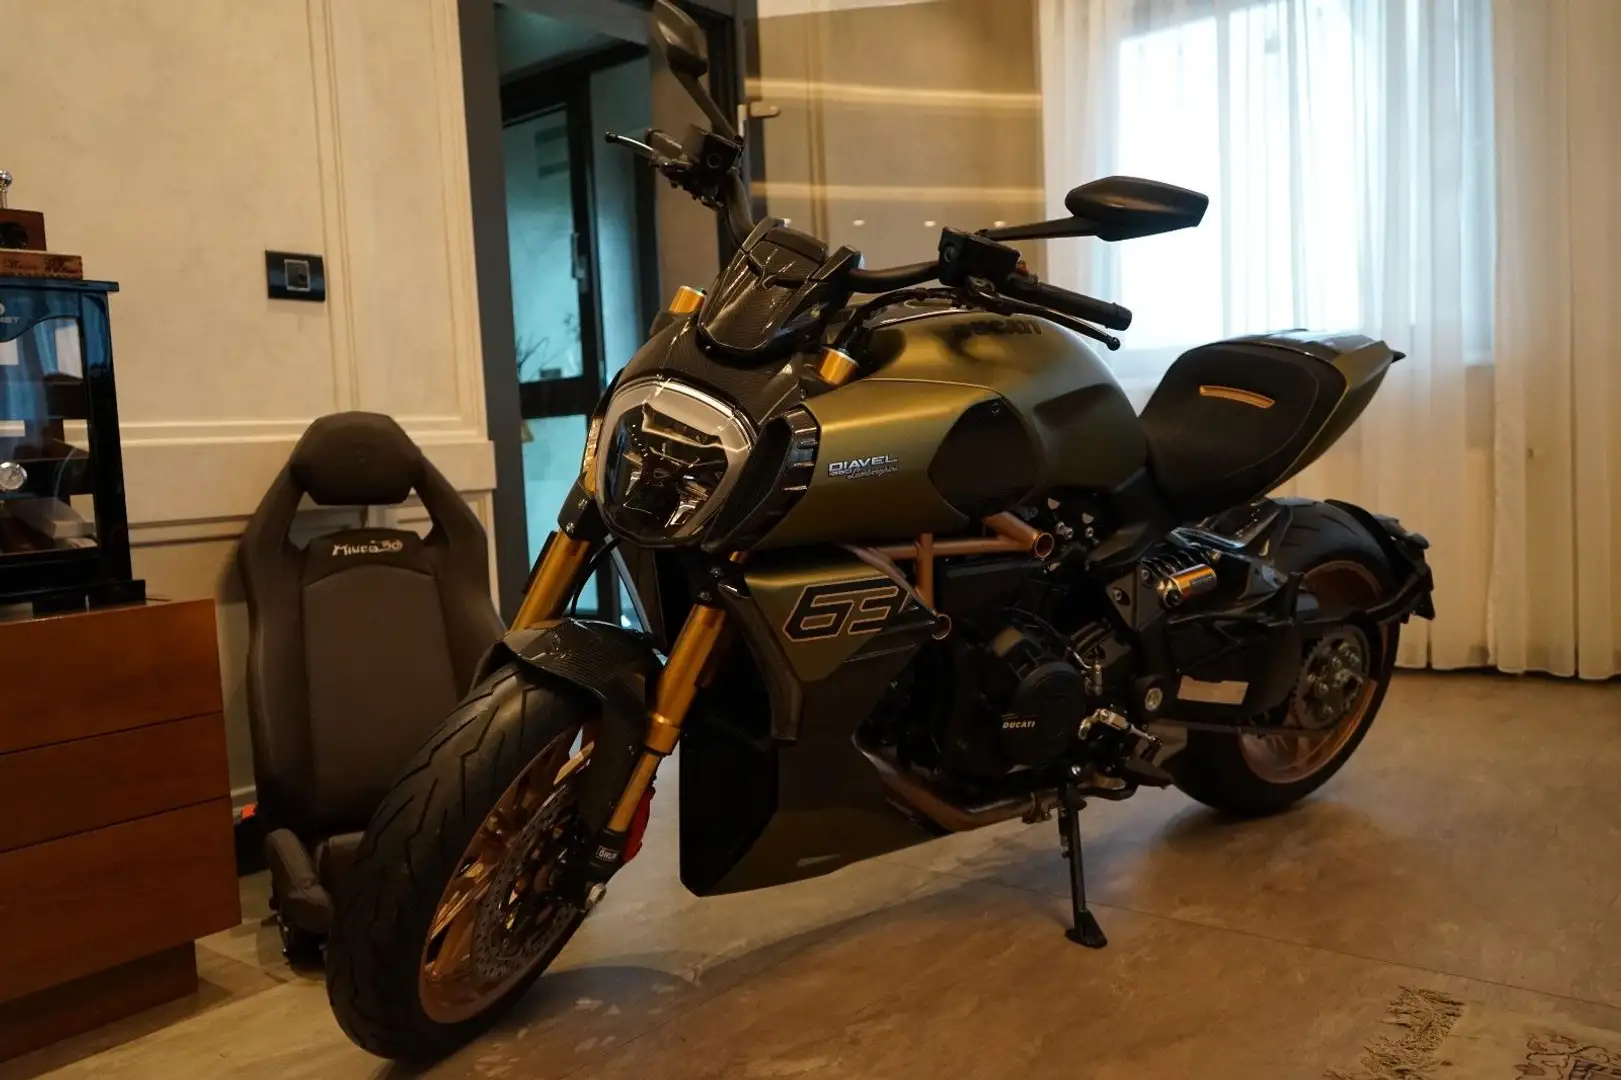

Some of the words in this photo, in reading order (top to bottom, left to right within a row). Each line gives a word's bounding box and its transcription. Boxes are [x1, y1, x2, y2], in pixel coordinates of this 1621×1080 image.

[828, 455, 898, 472] DIAVEL
[783, 576, 910, 642] 63
[1002, 720, 1036, 729] DUCATI
